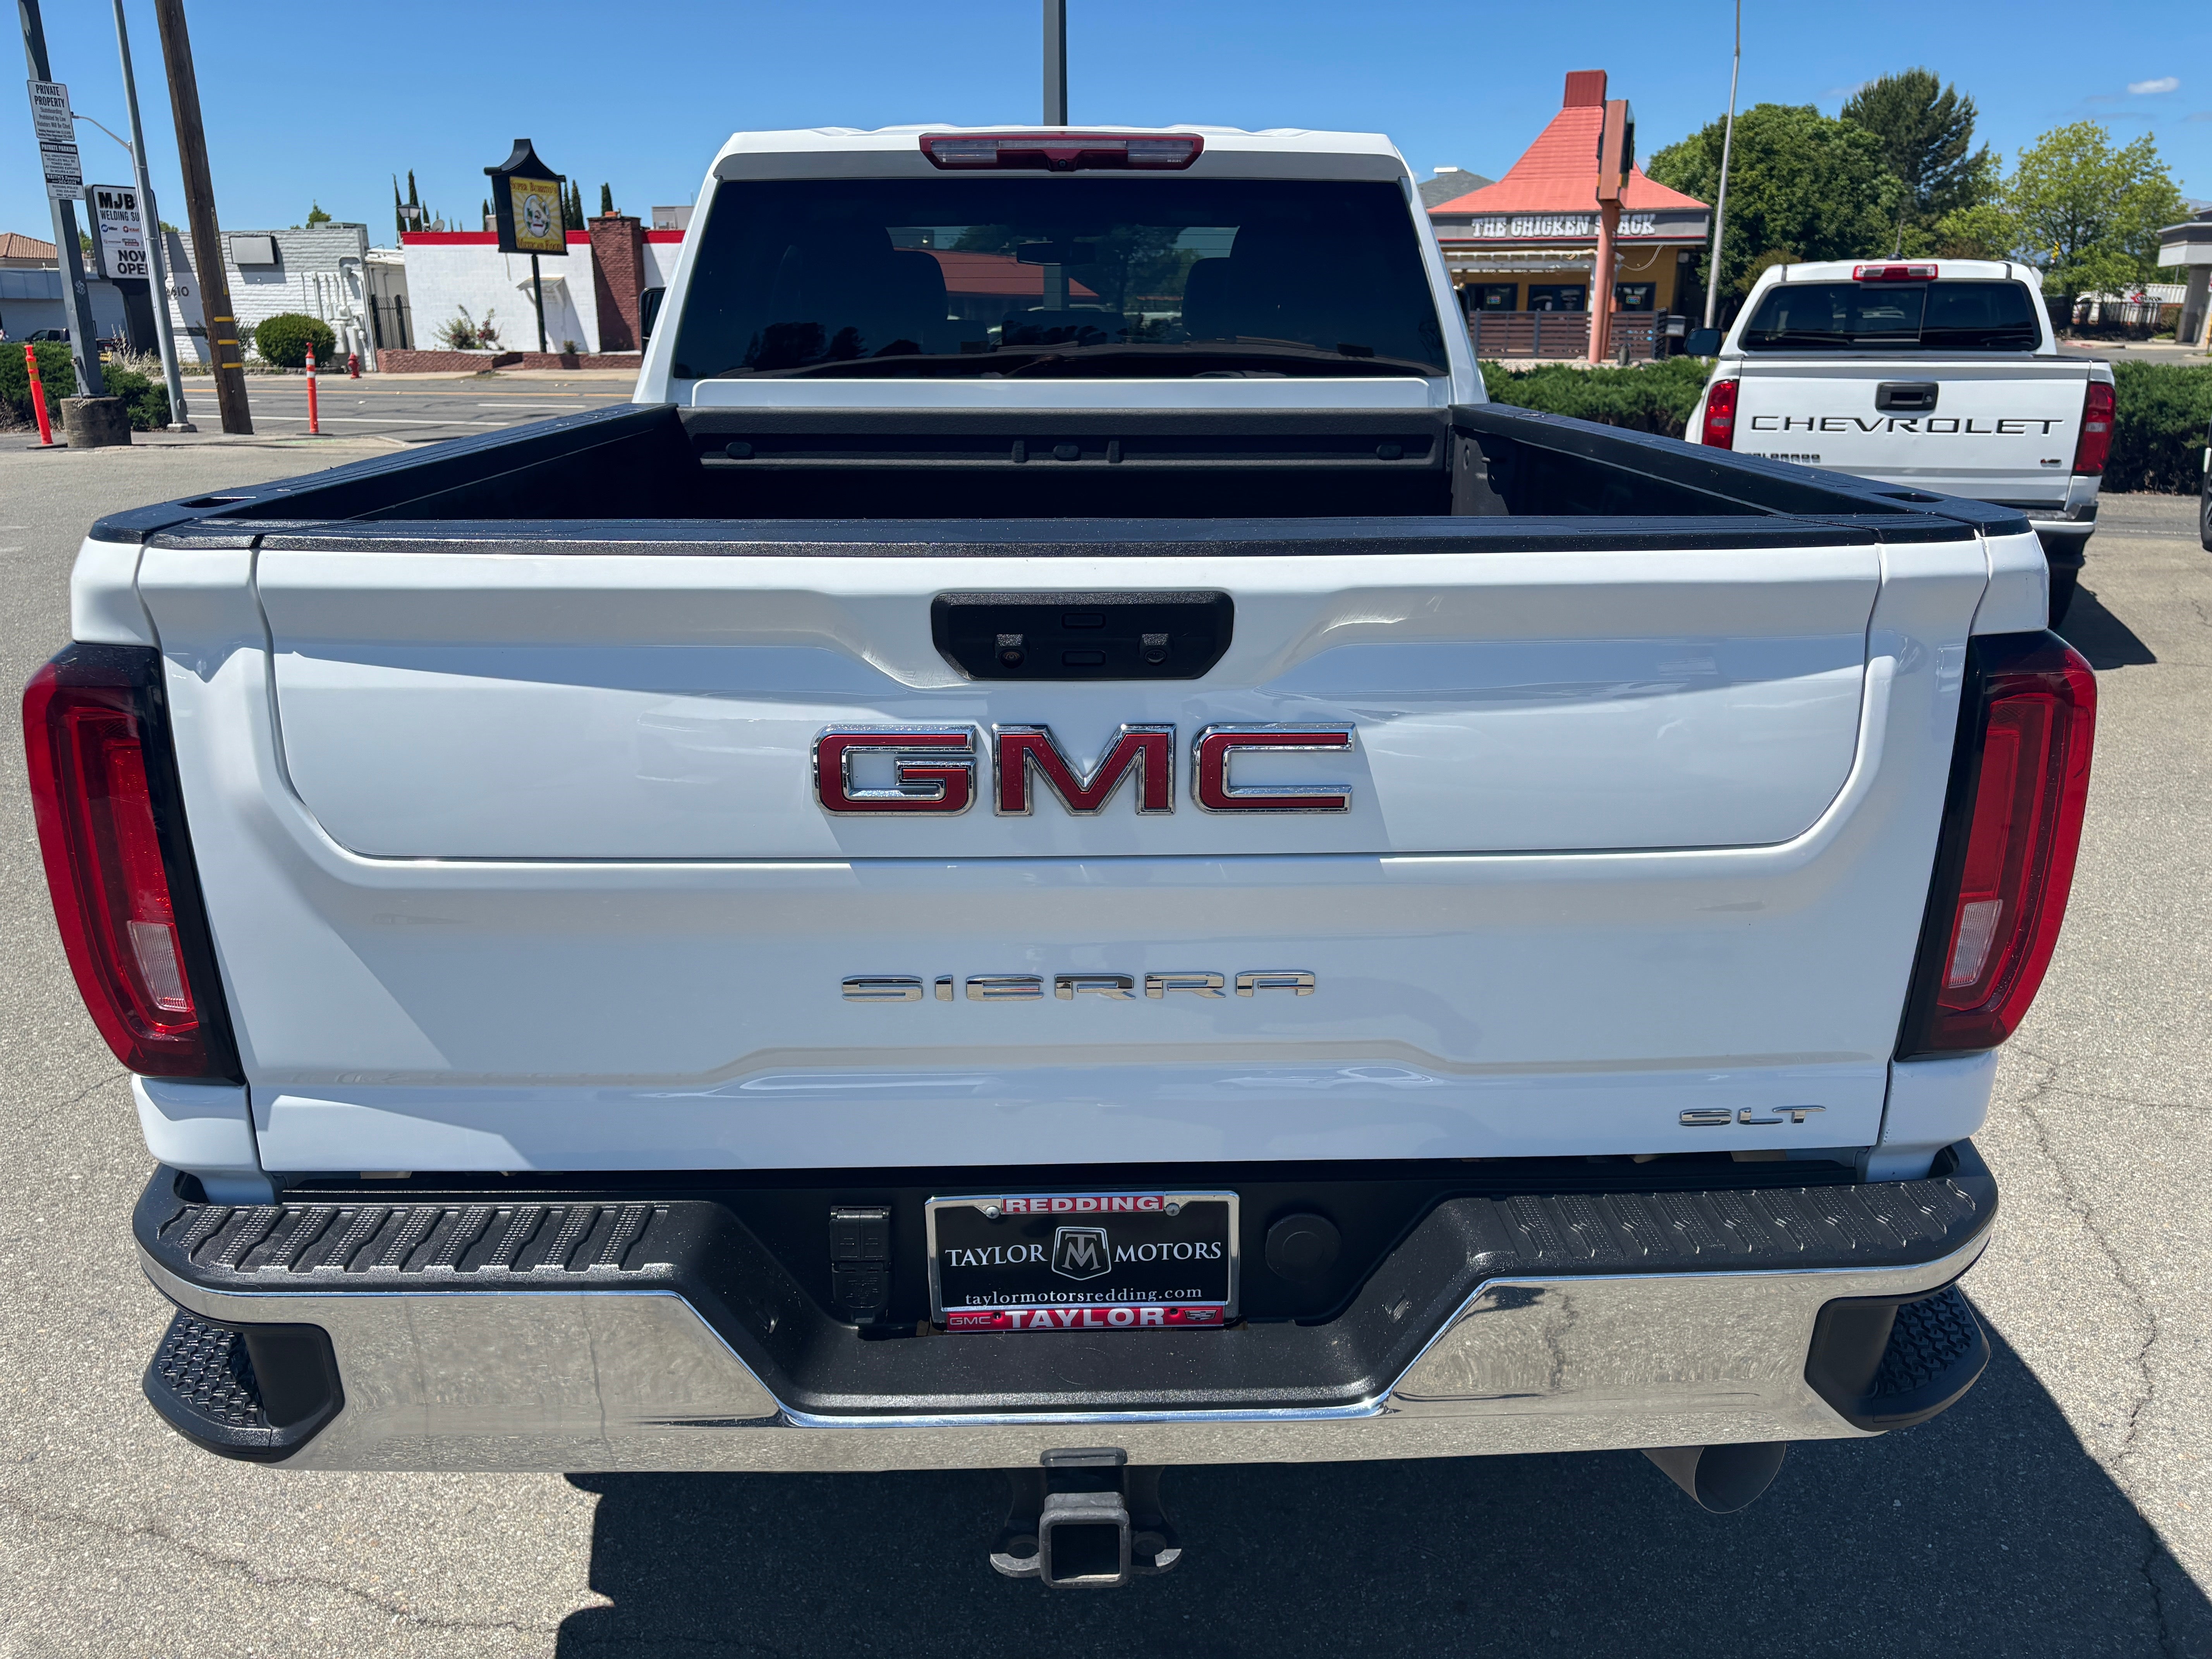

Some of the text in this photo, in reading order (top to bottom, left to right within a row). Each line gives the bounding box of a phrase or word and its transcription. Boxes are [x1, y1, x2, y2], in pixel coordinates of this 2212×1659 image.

[35, 84, 60, 96] PRIVATE
[34, 95, 65, 108] PROPERTY
[98, 192, 135, 210] MJB
[100, 210, 129, 221] WELDING
[1472, 213, 1656, 238] THE CHICKEN SACK
[117, 263, 148, 275] OPE
[1751, 415, 2066, 437] CHEVROLET
[812, 721, 1355, 817] GMC
[841, 969, 1316, 1002] SIERRA
[1678, 1104, 1826, 1127] SLT
[1006, 1196, 1160, 1212] REDDING
[945, 1244, 1048, 1267] TAYLOR
[1114, 1242, 1221, 1263] MOTORS
[965, 1287, 1202, 1307] taylormotorsredding.com
[950, 1307, 1165, 1328] GMC TAYLOR
